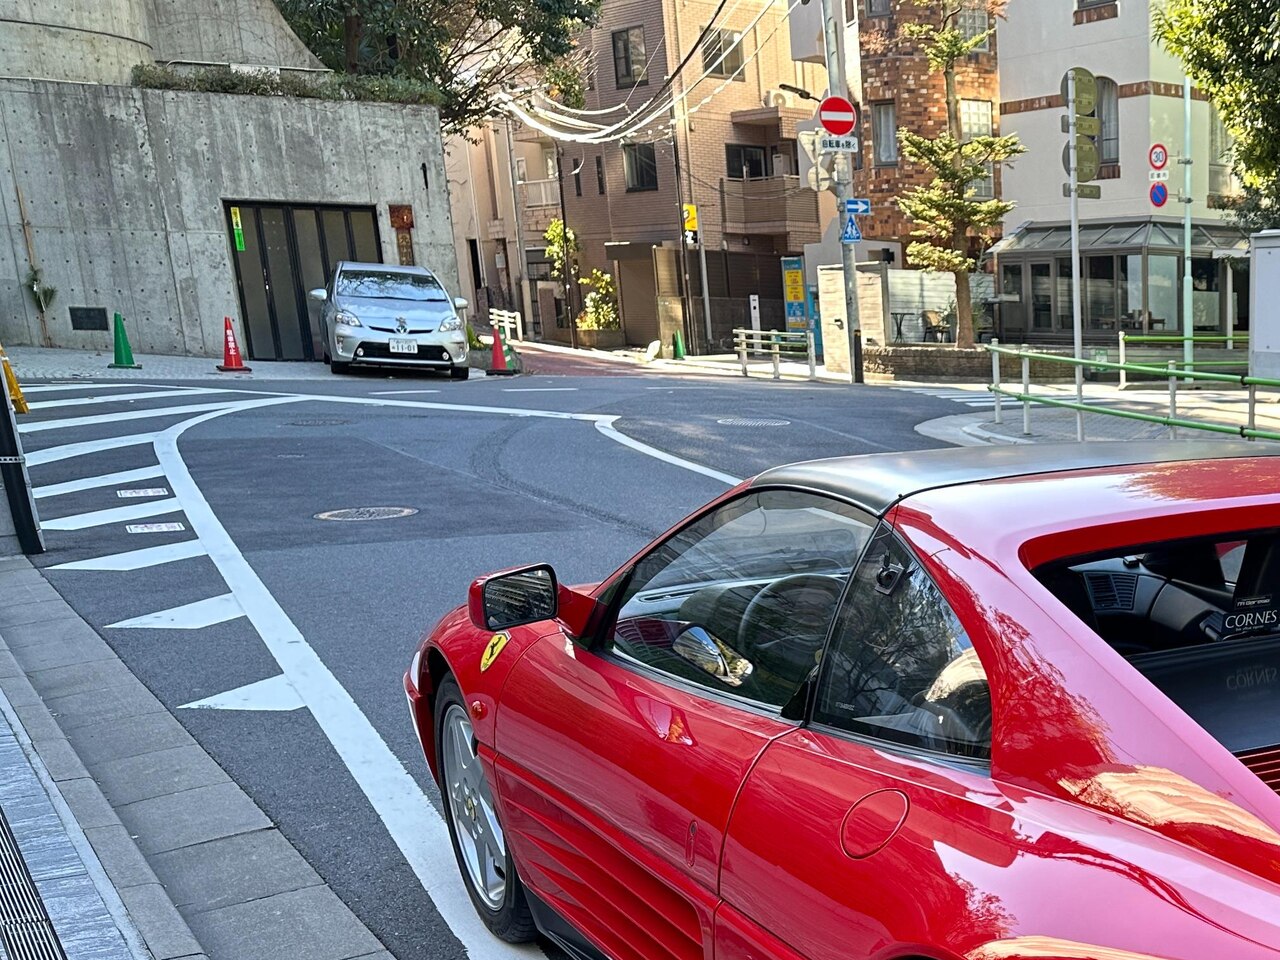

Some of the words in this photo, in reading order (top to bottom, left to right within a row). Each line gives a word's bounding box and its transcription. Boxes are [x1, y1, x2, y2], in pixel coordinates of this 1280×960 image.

[822, 139, 856, 149] 自転車を除く
[1153, 150, 1164, 163] 30
[1225, 609, 1278, 629] CORNES
